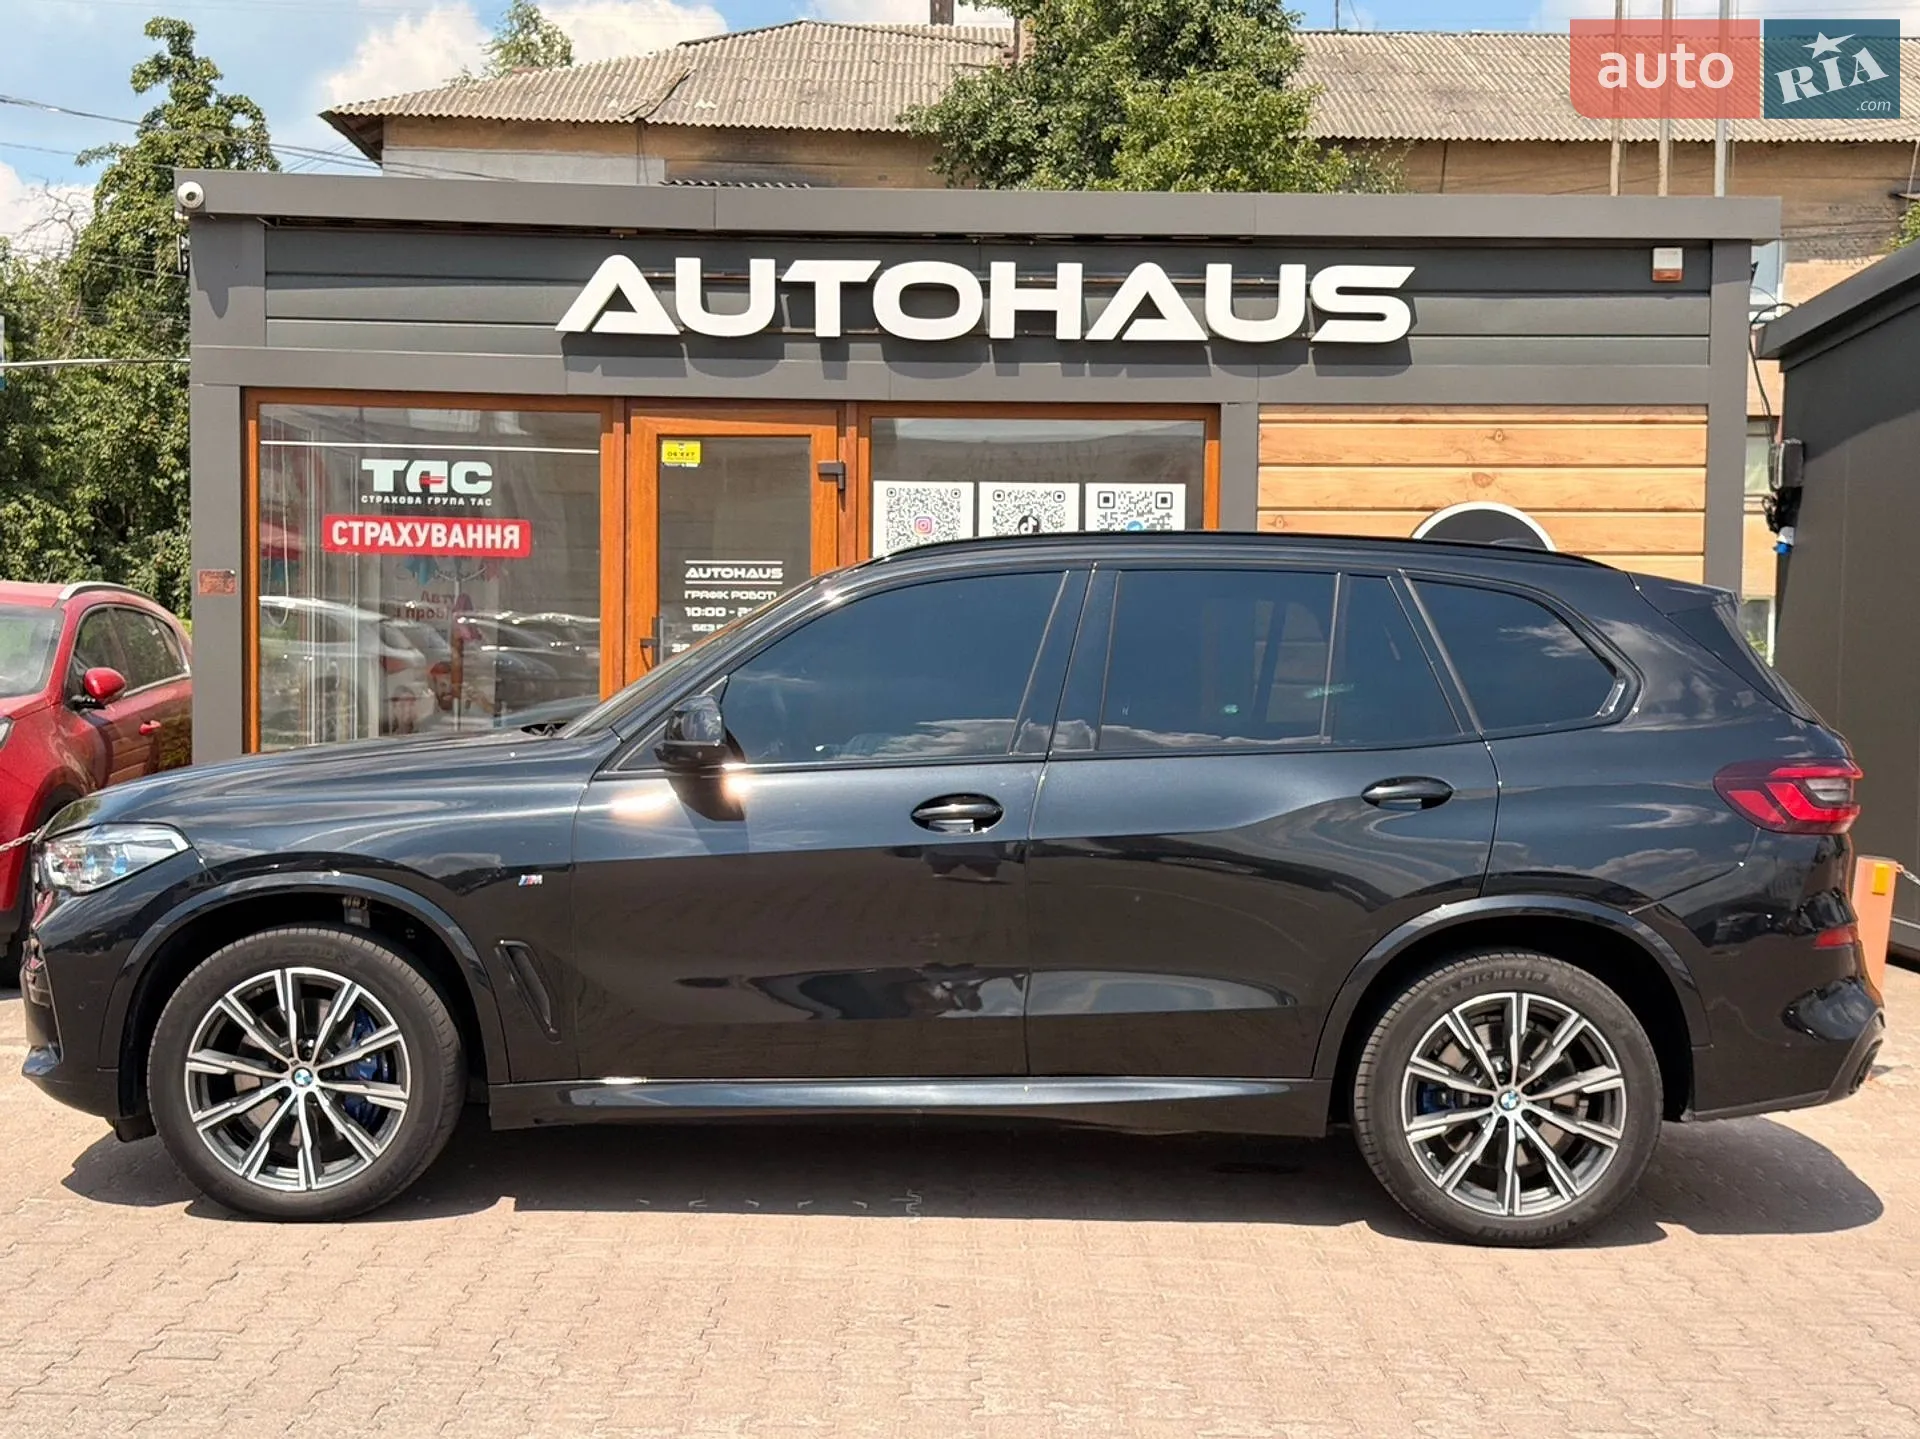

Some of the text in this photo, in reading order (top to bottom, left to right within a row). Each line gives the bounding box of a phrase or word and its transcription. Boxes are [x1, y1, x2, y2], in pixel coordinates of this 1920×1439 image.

[554, 254, 1416, 343] AUTOHAUS
[361, 495, 493, 507] СТРАХОВА ГРУПА ТАС
[331, 520, 520, 549] СТРАХУВАННЯ
[685, 567, 783, 579] AUTOHAUS
[684, 607, 726, 617] 10:00
